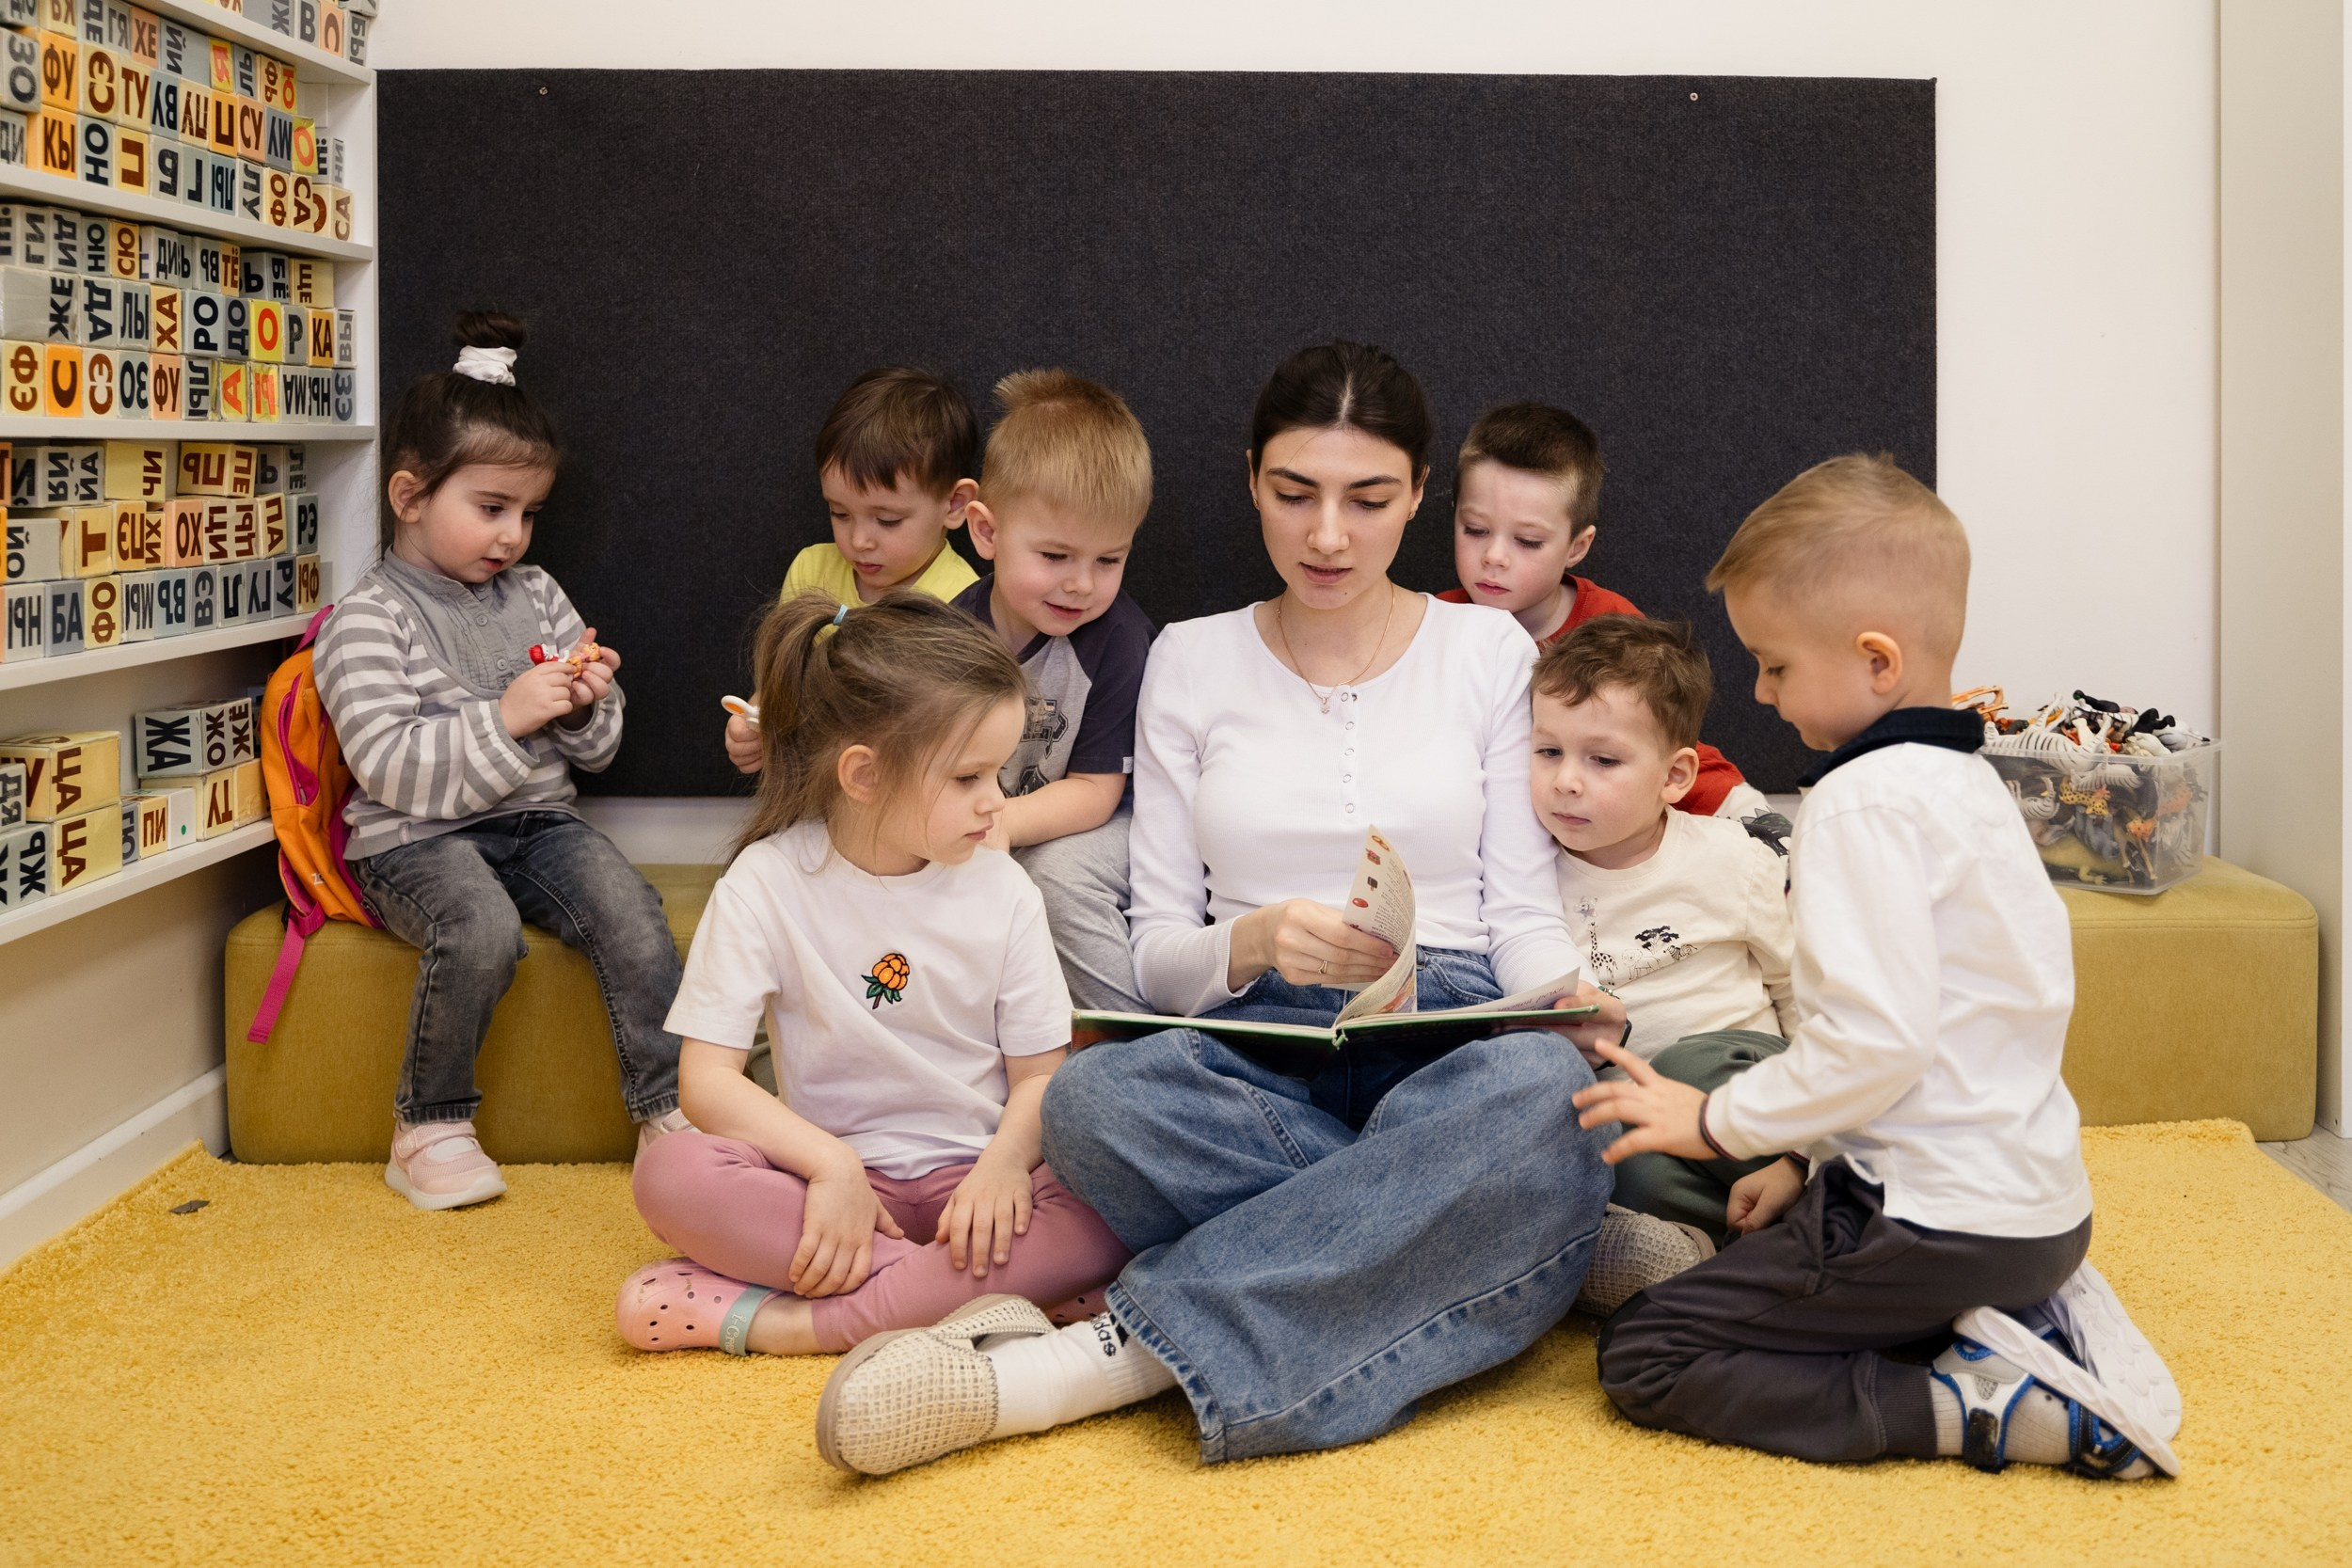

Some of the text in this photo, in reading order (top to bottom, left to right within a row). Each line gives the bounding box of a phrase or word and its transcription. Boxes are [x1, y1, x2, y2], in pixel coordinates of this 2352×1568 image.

[108, 8, 129, 49] ГЯ
[134, 19, 157, 59] ХЕ
[300, 2, 315, 43] В
[8, 35, 37, 103] ЗО
[43, 43, 75, 101] ФУ
[121, 67, 150, 119] ТУ
[283, 68, 294, 110] Ю
[151, 81, 178, 131] ВУ
[240, 104, 263, 150] СУ
[43, 117, 75, 173] КЫ
[294, 125, 314, 167] О
[294, 176, 311, 227] СА
[335, 196, 351, 242] СА
[118, 227, 135, 276] СЮ
[156, 237, 178, 280] ДИ
[222, 246, 239, 289] ТЁ
[49, 277, 74, 341] ЖЕ
[84, 279, 113, 342] ДА
[120, 292, 150, 341] ЛЫ
[156, 293, 178, 351] ХА
[194, 295, 218, 352] РО
[228, 299, 249, 356] ДО
[258, 308, 278, 351] О
[288, 314, 303, 355] Р
[312, 317, 333, 358] КА
[153, 364, 181, 412] ФУ
[222, 368, 243, 415] А
[142, 450, 163, 497] ЧИ
[232, 451, 253, 495] ПЕ
[81, 520, 107, 568] Т
[265, 497, 284, 553] ПА
[297, 502, 318, 546] РЭ
[52, 592, 85, 645] БА
[144, 715, 192, 772] ЖА
[206, 708, 227, 767] ЖО
[51, 746, 82, 816] ЦА
[143, 807, 167, 848] ПИ
[56, 817, 87, 888] ЦА
